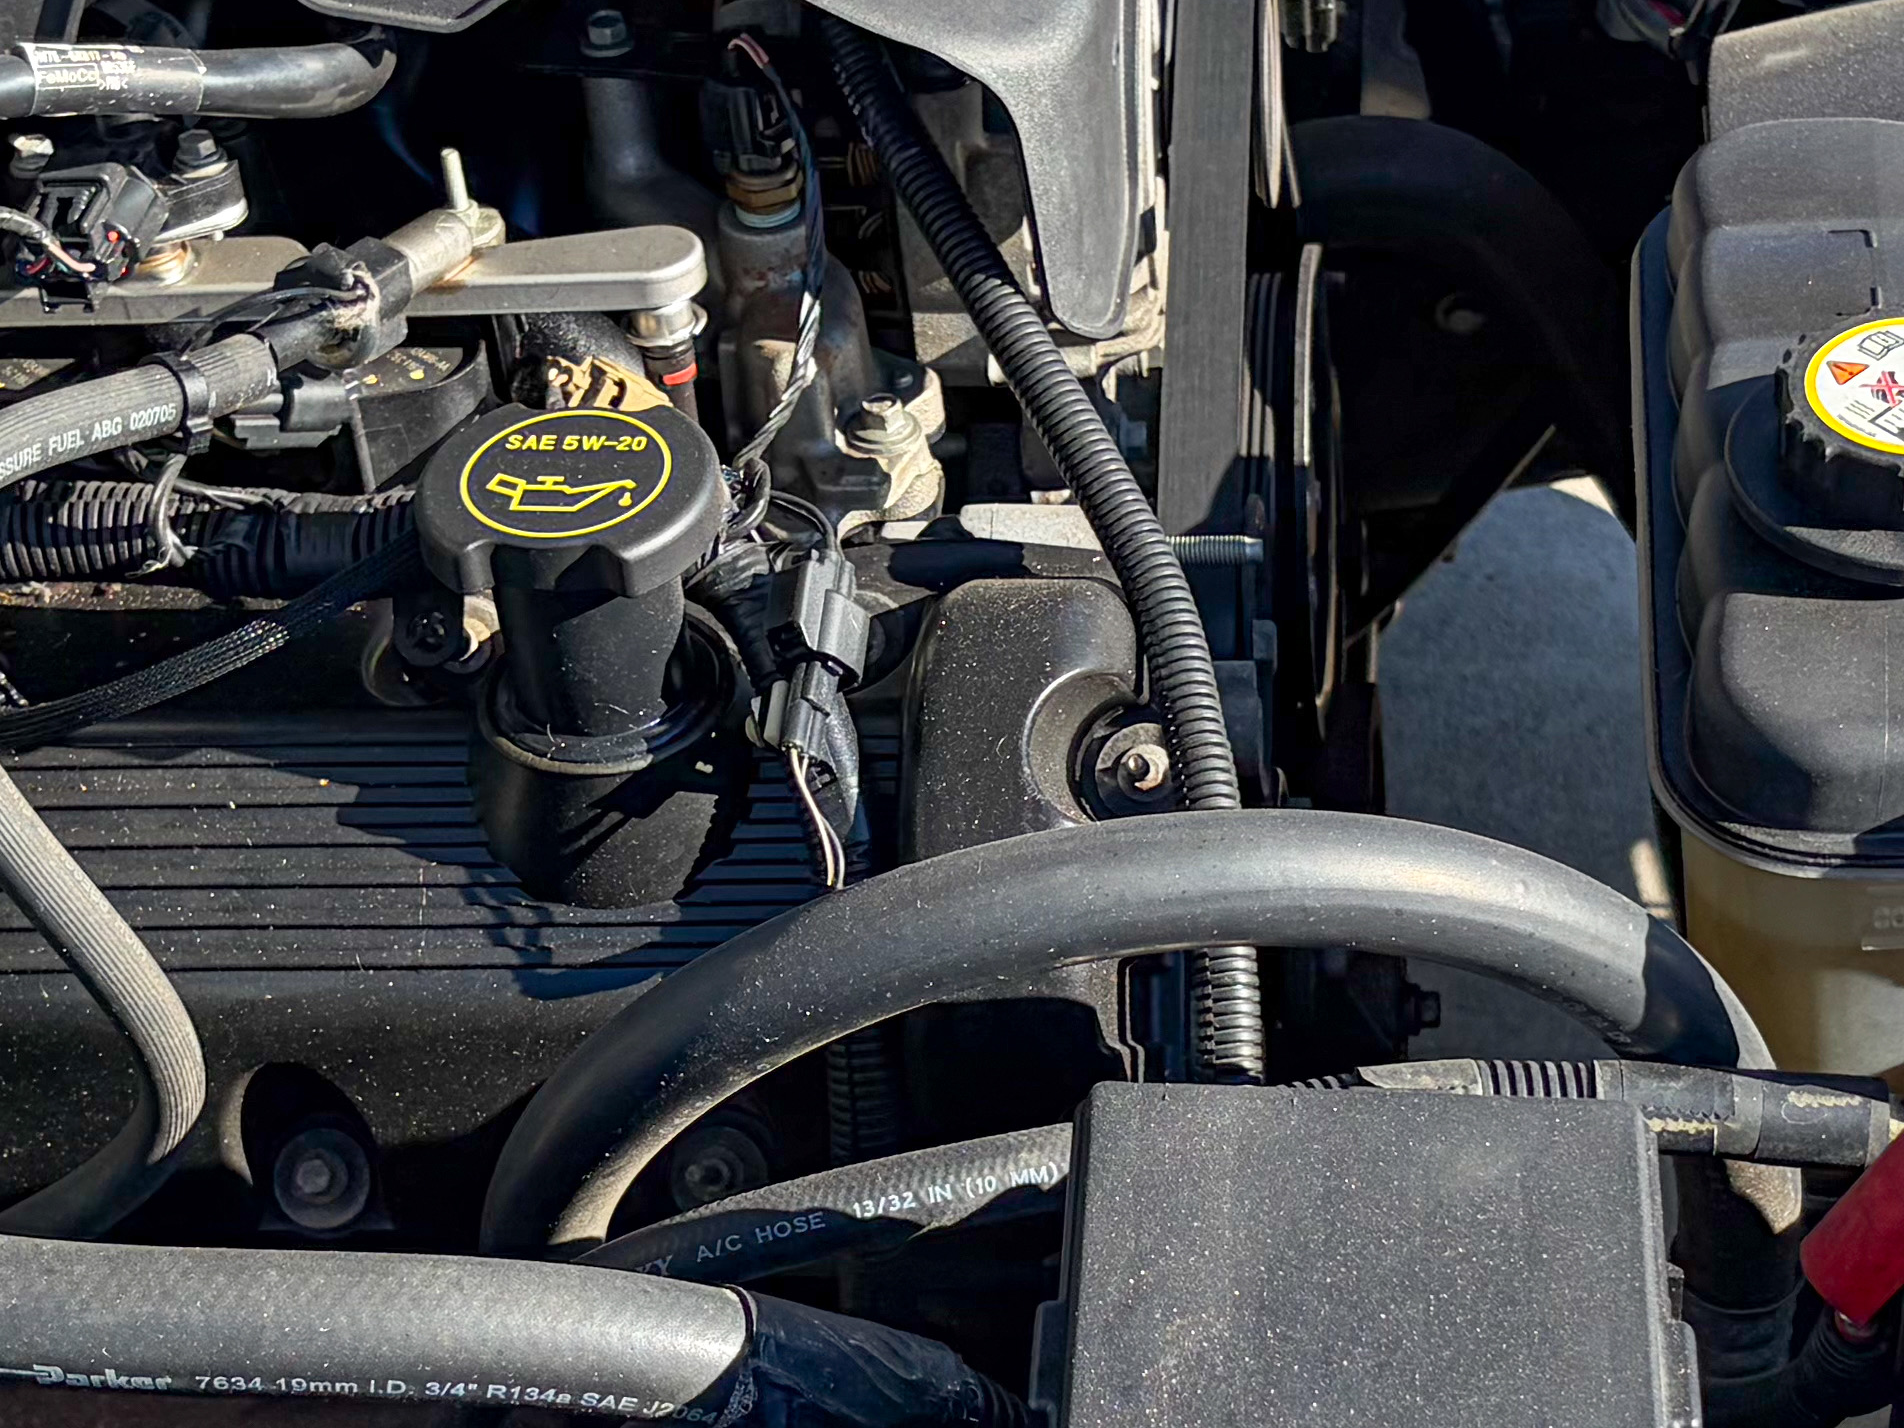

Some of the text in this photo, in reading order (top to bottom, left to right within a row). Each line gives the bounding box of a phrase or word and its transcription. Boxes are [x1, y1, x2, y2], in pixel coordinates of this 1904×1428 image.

[49, 429, 84, 456] FUEL
[92, 418, 122, 442] ABG
[130, 403, 177, 428] 020705
[505, 434, 648, 452] SAE 5W-20
[696, 1162, 1057, 1263] A/C HOSE 13/32 IN (10 MM)
[196, 1375, 264, 1391] 7634
[275, 1377, 358, 1394] 19mm
[425, 1380, 478, 1398] 3/4"
[486, 1384, 571, 1406] R134a
[580, 1392, 638, 1413] SAE
[643, 1399, 717, 1426] J2064
